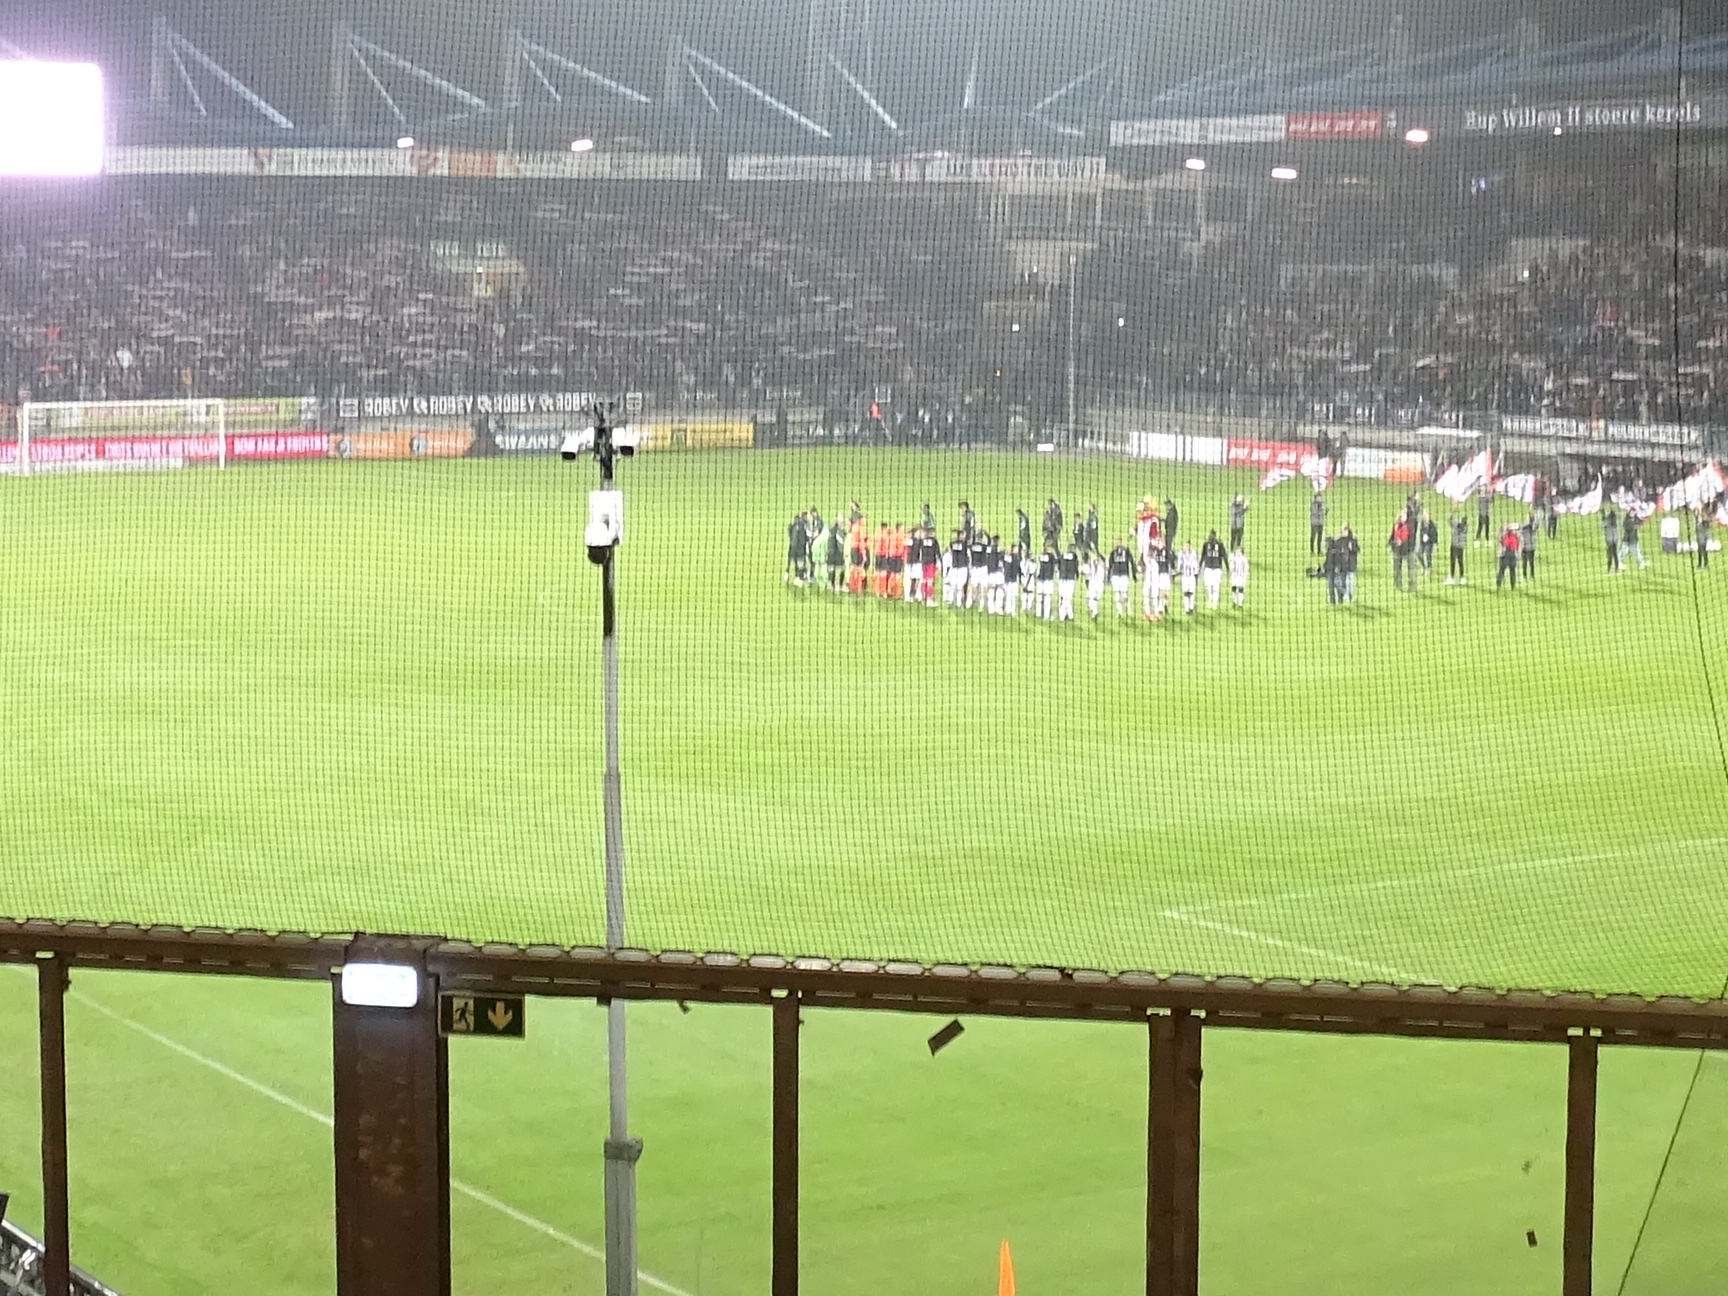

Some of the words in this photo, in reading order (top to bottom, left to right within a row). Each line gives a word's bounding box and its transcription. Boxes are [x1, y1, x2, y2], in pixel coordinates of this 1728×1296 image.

[1501, 106, 1562, 128] Willem
[364, 397, 410, 417] ROBEY
[429, 395, 475, 415] ROBEY
[493, 394, 537, 414] ROBEY
